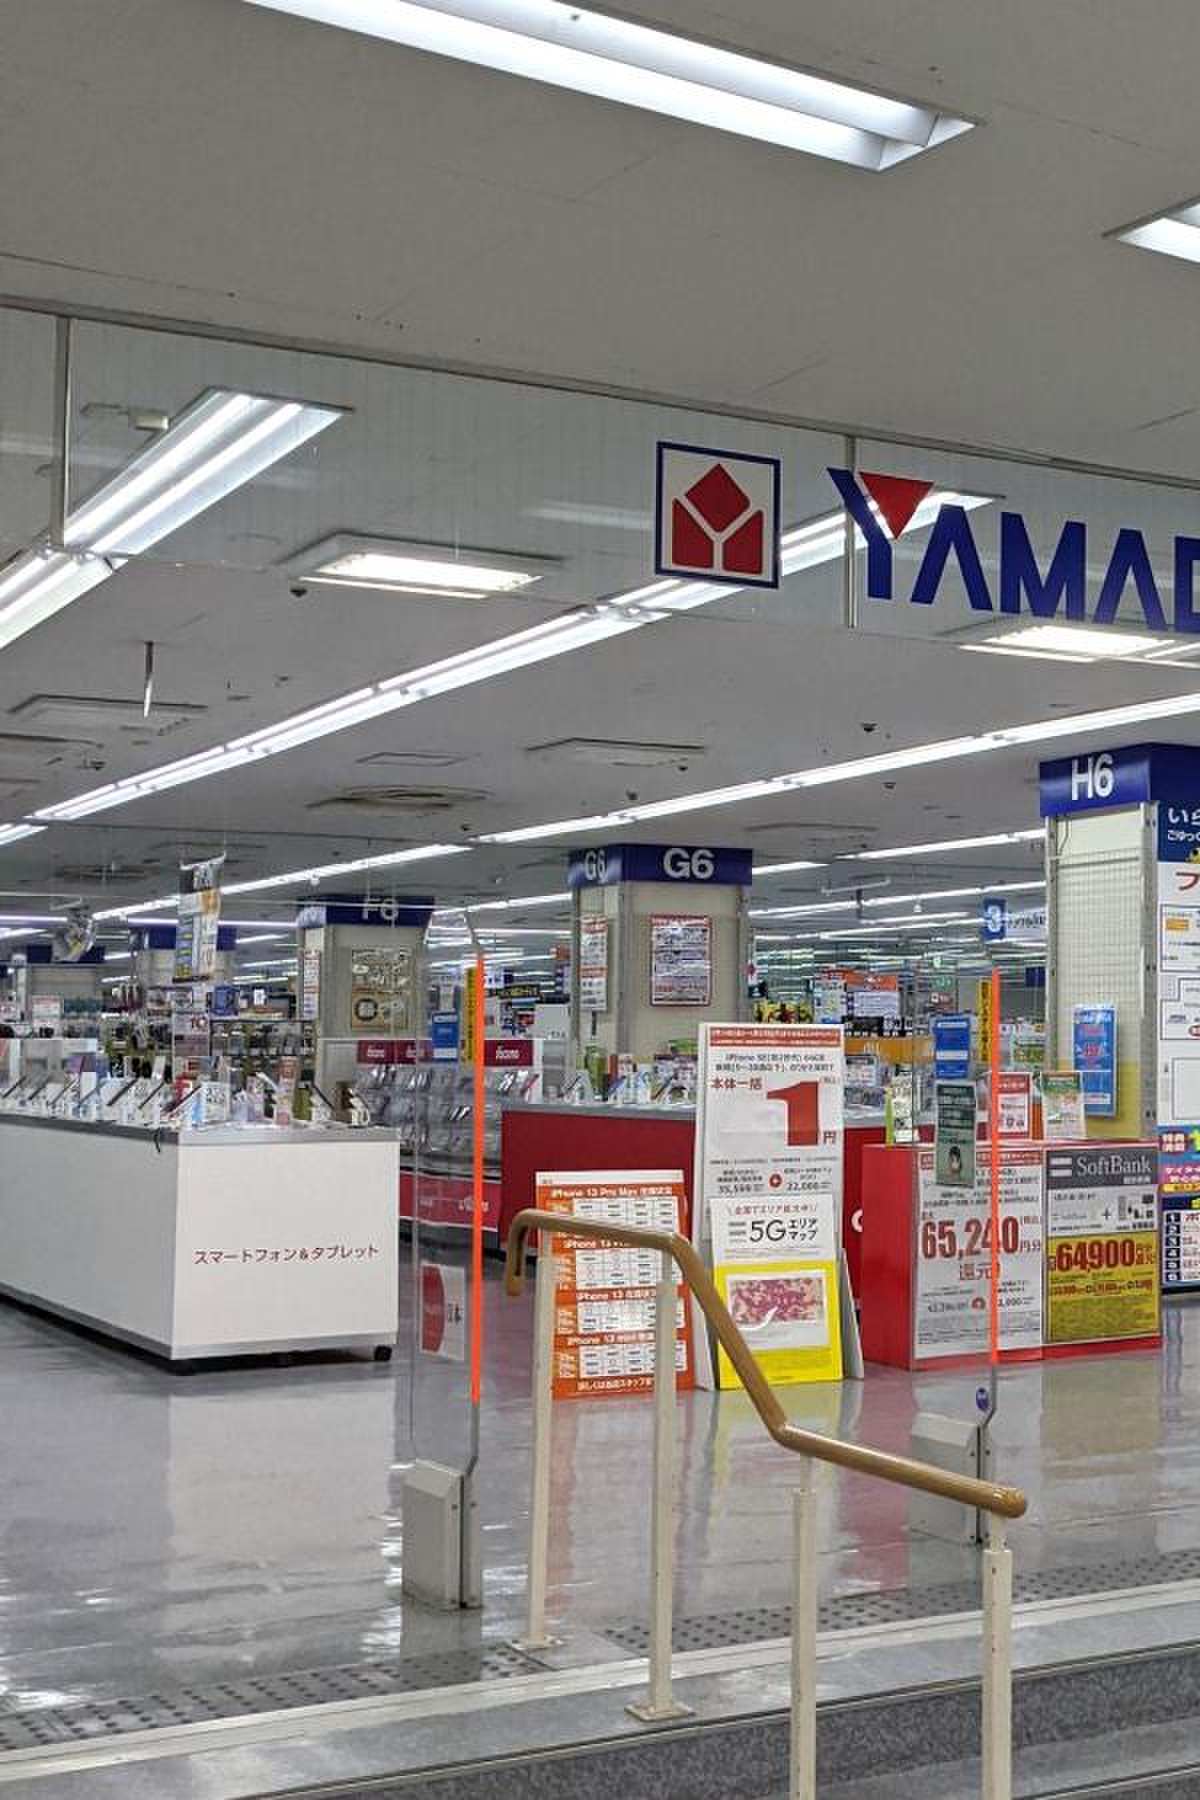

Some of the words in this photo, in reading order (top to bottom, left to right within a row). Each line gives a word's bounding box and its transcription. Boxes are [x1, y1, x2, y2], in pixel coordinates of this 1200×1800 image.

[1071, 753, 1114, 800] H6
[663, 848, 716, 879] G6
[767, 1081, 818, 1146] 1
[1077, 1155, 1151, 1177] SoftBank
[750, 1219, 786, 1242] 5G
[195, 1245, 379, 1265] スマートフォン&タブレット
